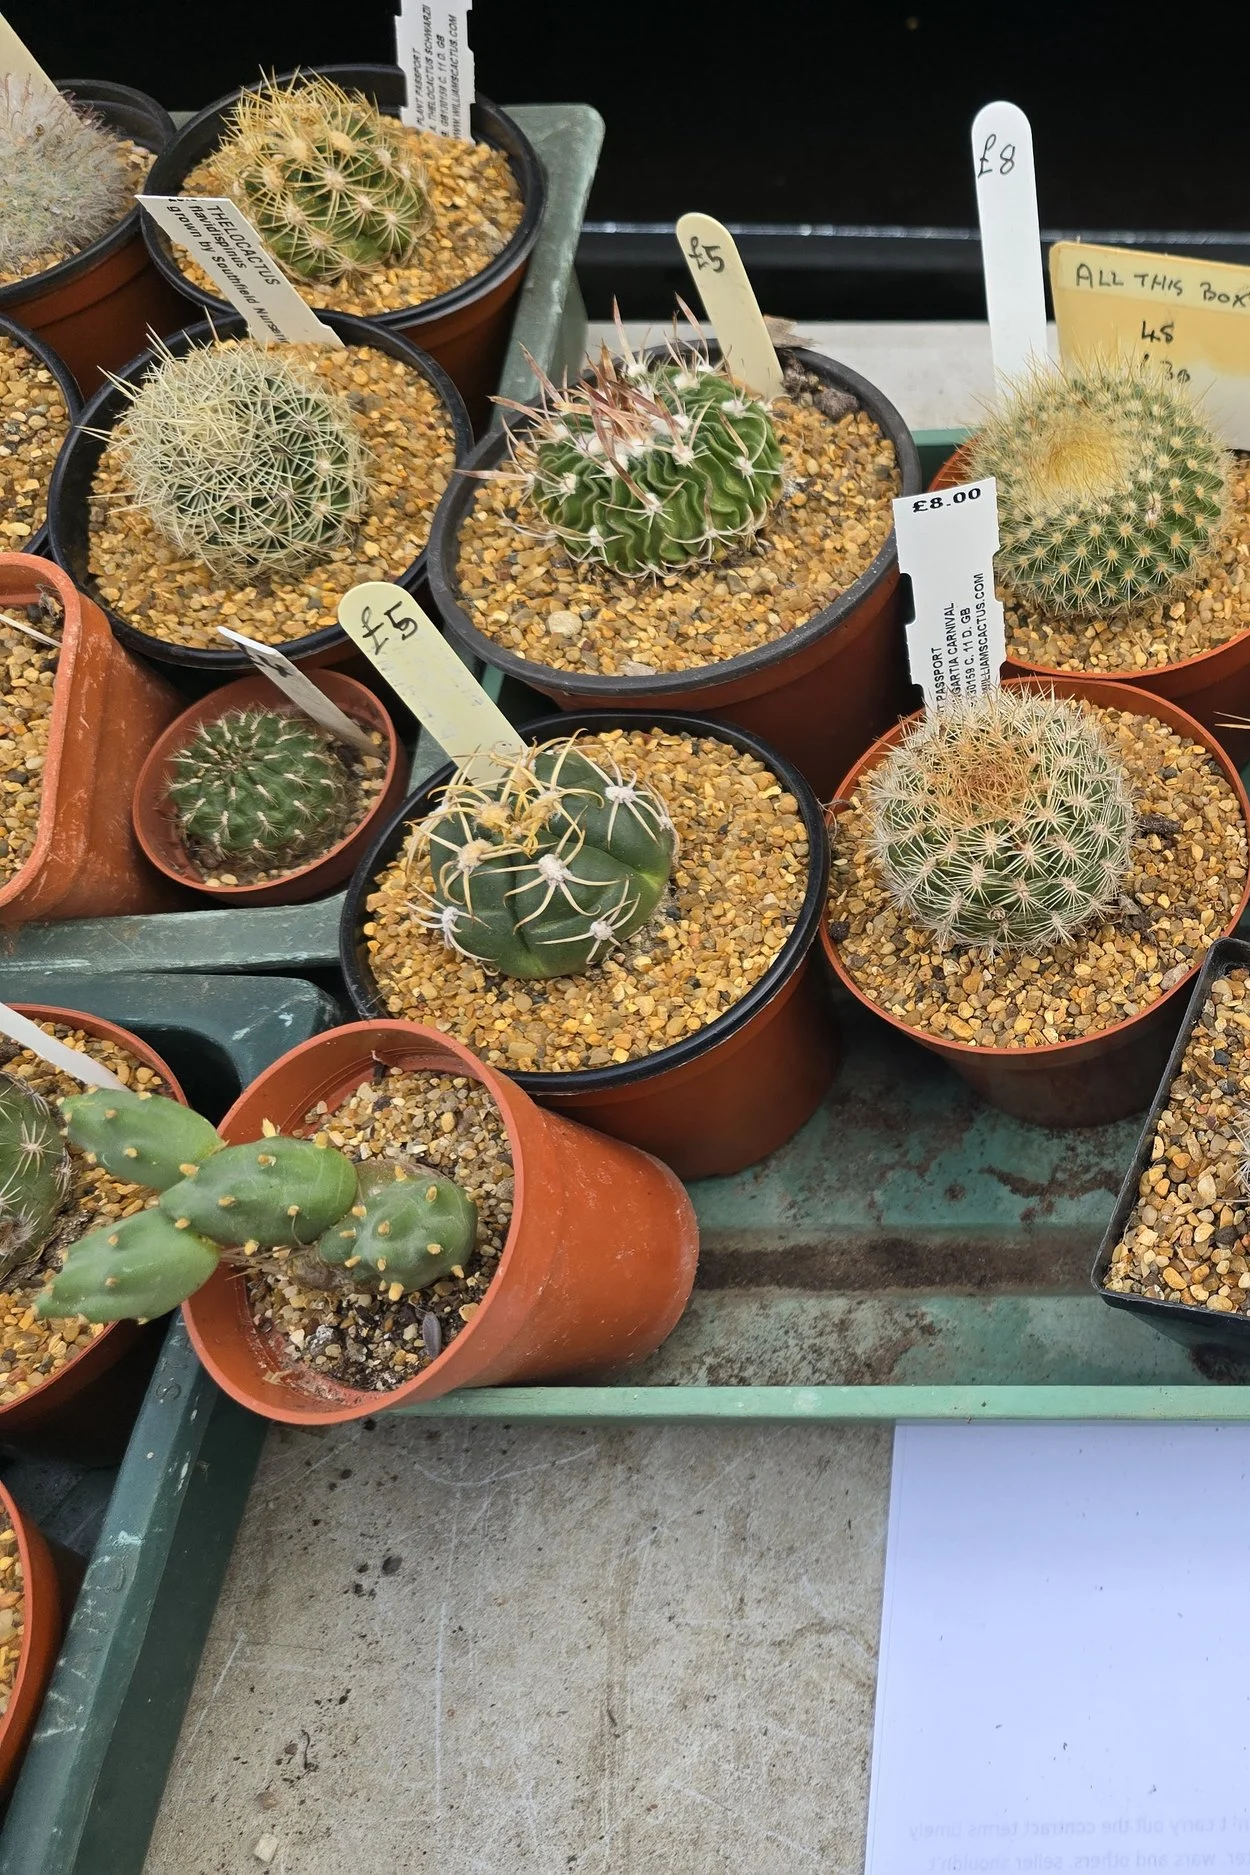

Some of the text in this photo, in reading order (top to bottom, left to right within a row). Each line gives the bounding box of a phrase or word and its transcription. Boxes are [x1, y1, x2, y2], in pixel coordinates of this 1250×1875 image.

[422, 4, 432, 56] SCHWARZII
[436, 34, 445, 49] GB
[412, 48, 424, 127] PLANT PASSPORT
[424, 57, 436, 122] THELOCACTUS
[978, 134, 1015, 179] £8
[167, 206, 202, 238] grown
[199, 241, 216, 253] by
[212, 256, 260, 304] Southfield
[188, 205, 248, 269] flavidispinus
[206, 205, 281, 286] THELOCACTUS
[688, 236, 726, 273] £5
[1075, 263, 1124, 289] ALL
[1133, 272, 1184, 296] THIS
[912, 487, 982, 513] £8.00
[361, 600, 419, 656] £5
[944, 603, 958, 656] CARNIVAL
[960, 607, 972, 624] GB
[962, 626, 973, 638] D.
[963, 640, 974, 652] 11
[965, 653, 975, 666] C.
[931, 648, 945, 702] PASSPORT
